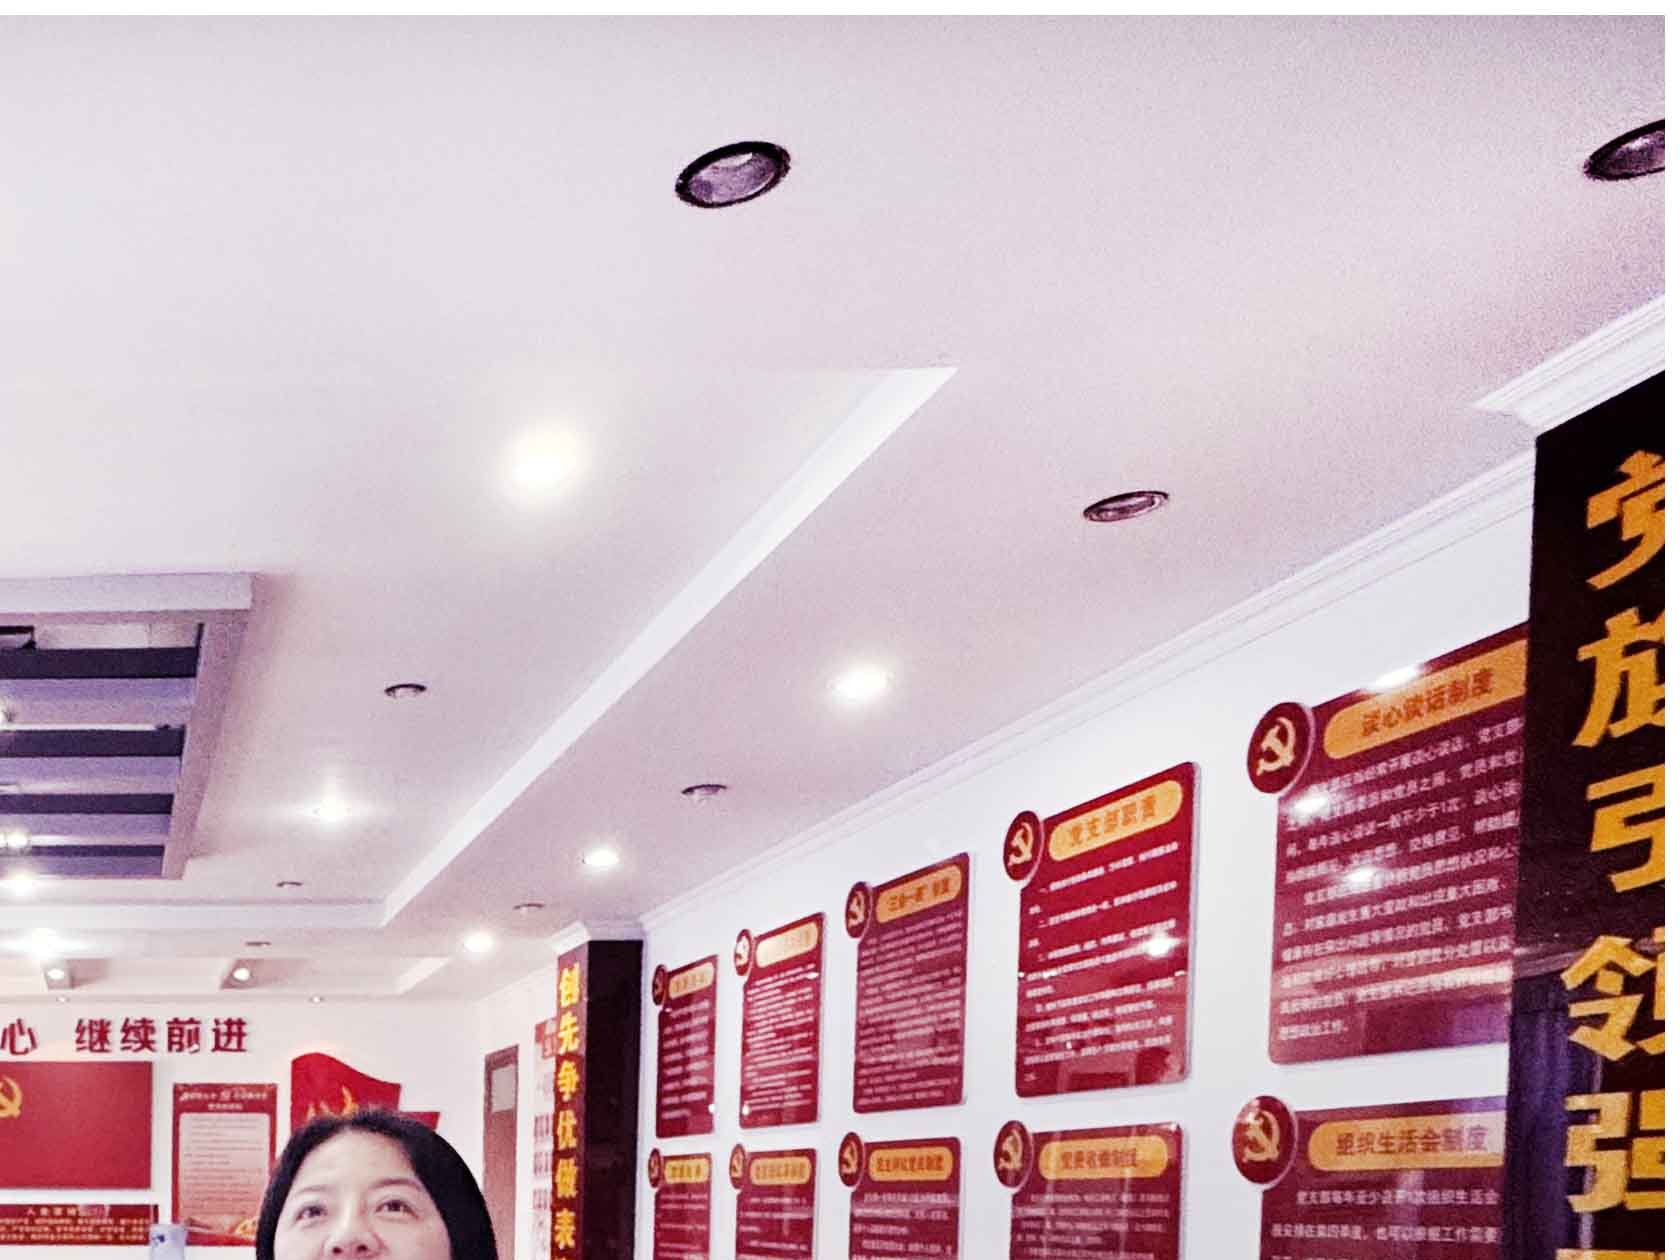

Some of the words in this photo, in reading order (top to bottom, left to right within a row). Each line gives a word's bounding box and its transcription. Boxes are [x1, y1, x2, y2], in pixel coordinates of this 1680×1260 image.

[75, 1017, 249, 1054] 继续前进
[1336, 1125, 1489, 1158] 组织生活会制度
